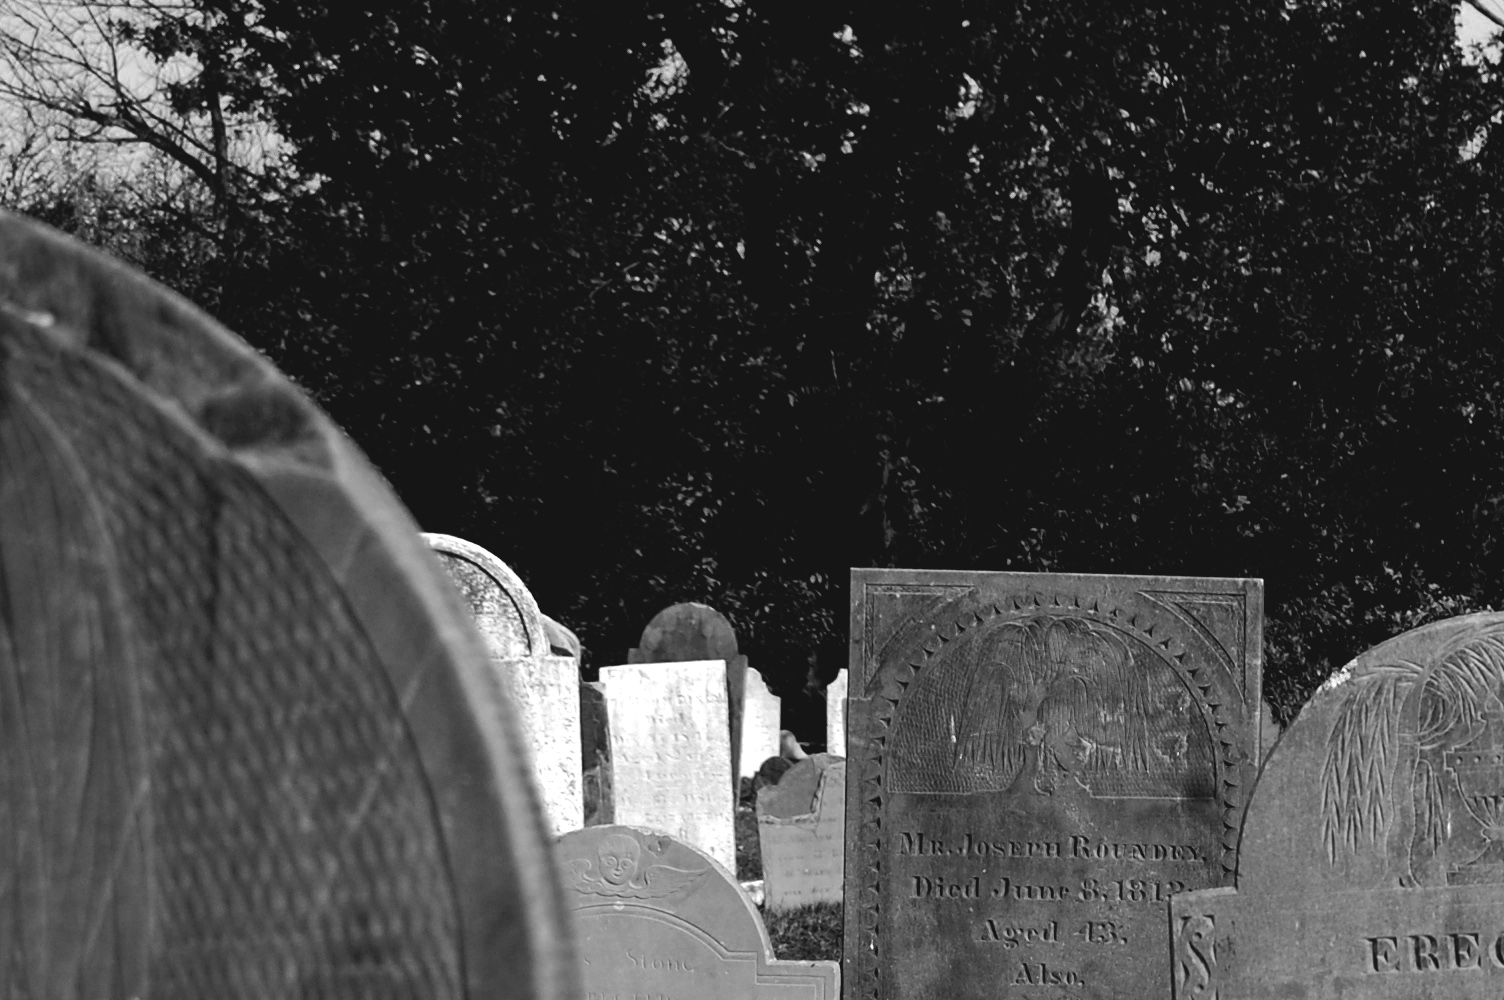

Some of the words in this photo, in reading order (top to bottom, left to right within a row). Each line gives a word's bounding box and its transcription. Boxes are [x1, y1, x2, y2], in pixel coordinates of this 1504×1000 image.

[911, 875, 980, 900] Died
[992, 876, 1071, 900] June
[976, 920, 1058, 950] Aged
